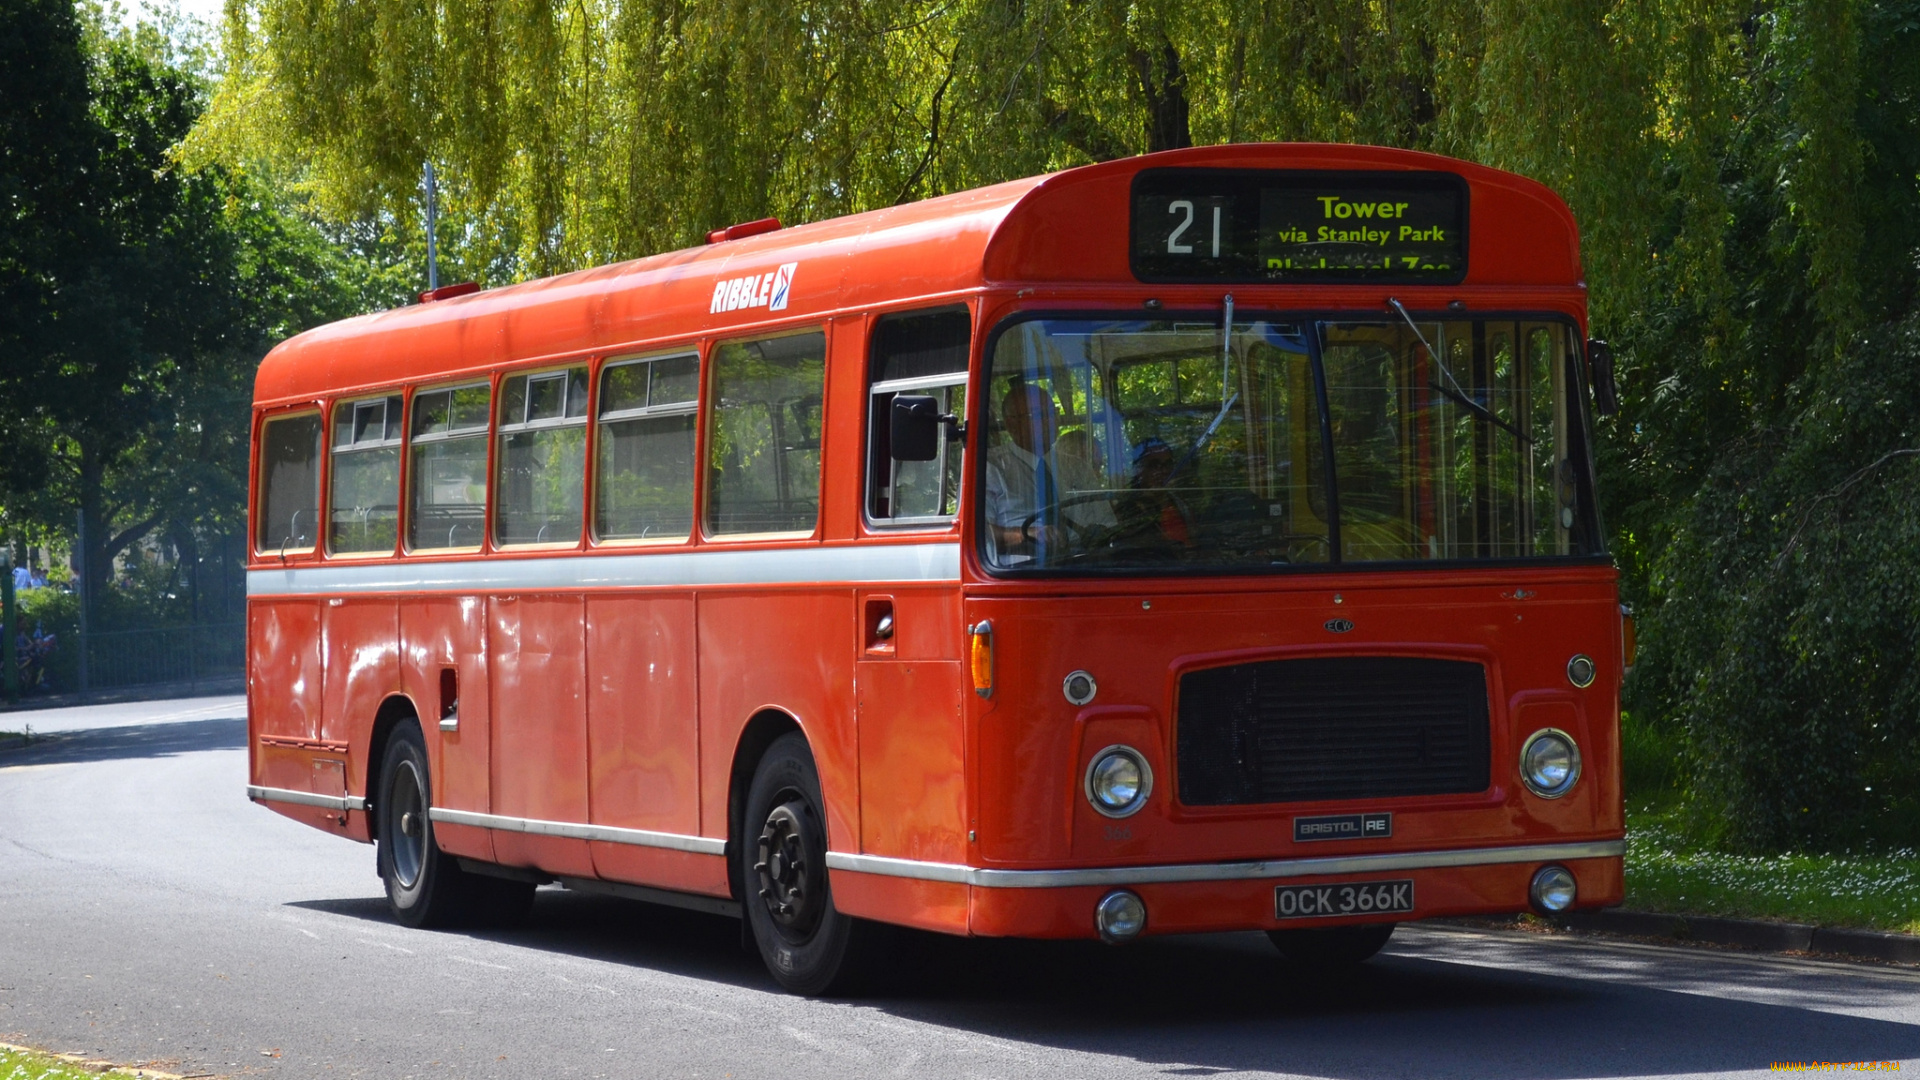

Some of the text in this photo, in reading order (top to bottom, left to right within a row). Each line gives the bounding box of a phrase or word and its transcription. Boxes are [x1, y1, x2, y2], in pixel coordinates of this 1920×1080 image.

[1317, 196, 1409, 219] Tower
[1167, 200, 1221, 258] 21
[1279, 225, 1445, 246] via Stanley Park
[710, 272, 775, 314] RIBBLE
[1301, 820, 1386, 834] BRISTOL RE
[1280, 884, 1408, 914] OCK 366K
